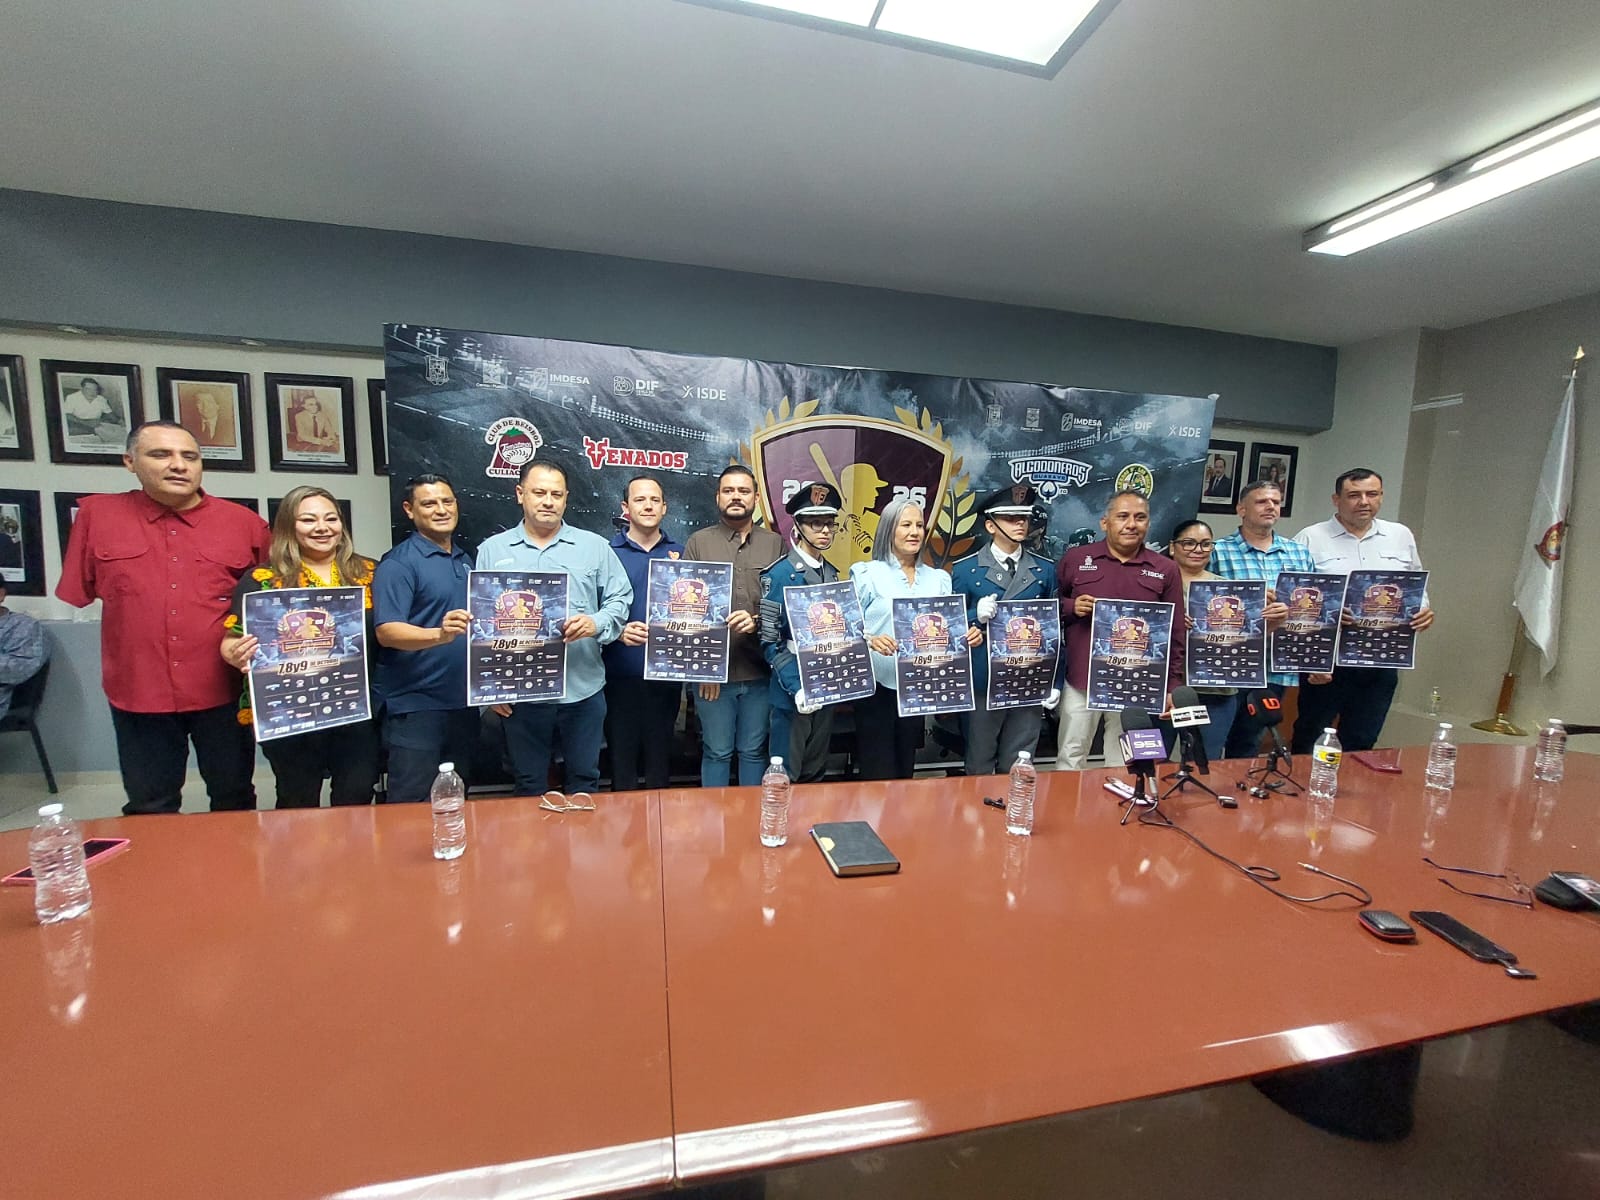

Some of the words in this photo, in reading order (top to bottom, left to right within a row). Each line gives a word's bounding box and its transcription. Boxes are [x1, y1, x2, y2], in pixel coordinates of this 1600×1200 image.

[550, 374, 590, 384] IMDESA
[635, 379, 660, 391] DIF
[697, 387, 727, 401] ISDE
[1073, 418, 1103, 426] IMDESA
[1135, 421, 1152, 431] DIF
[488, 424, 502, 441] CLUB
[1179, 427, 1201, 438] ISDE
[583, 438, 685, 468] VENADOS
